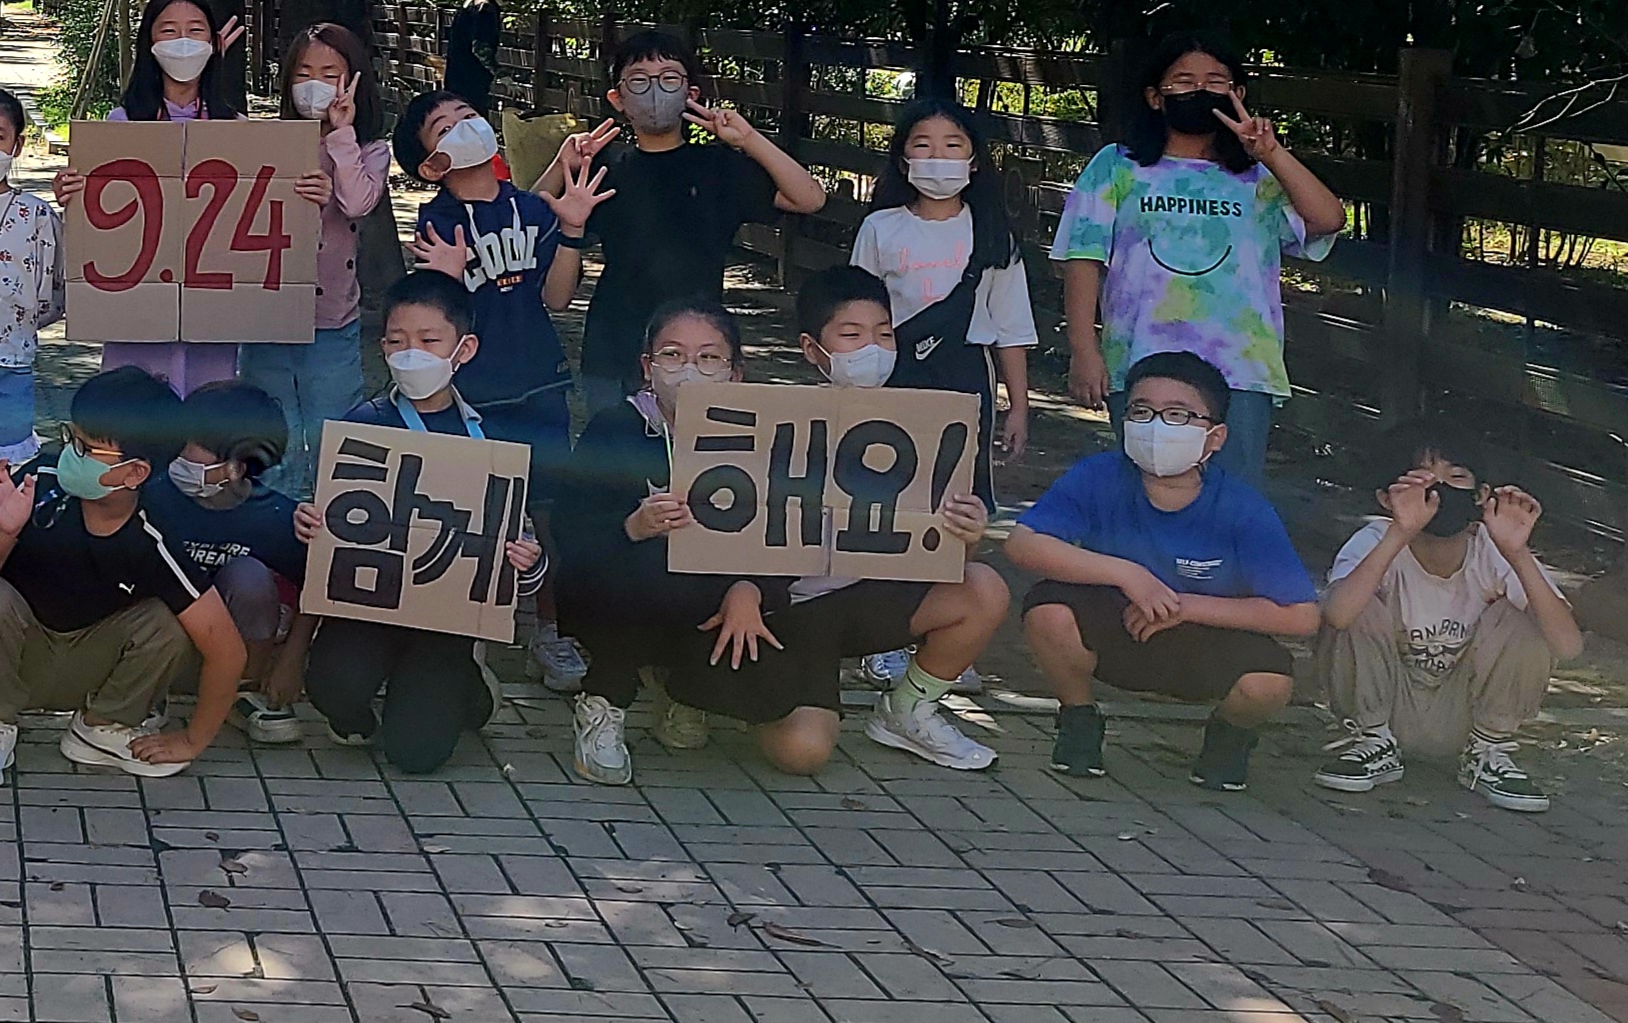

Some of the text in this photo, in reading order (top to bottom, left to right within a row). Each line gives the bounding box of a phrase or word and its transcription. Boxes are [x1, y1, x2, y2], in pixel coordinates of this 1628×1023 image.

[83, 158, 291, 292] 9.24
[1140, 196, 1242, 217] HAPPINESS
[325, 437, 525, 609] 함께
[687, 406, 969, 554] 해요!
